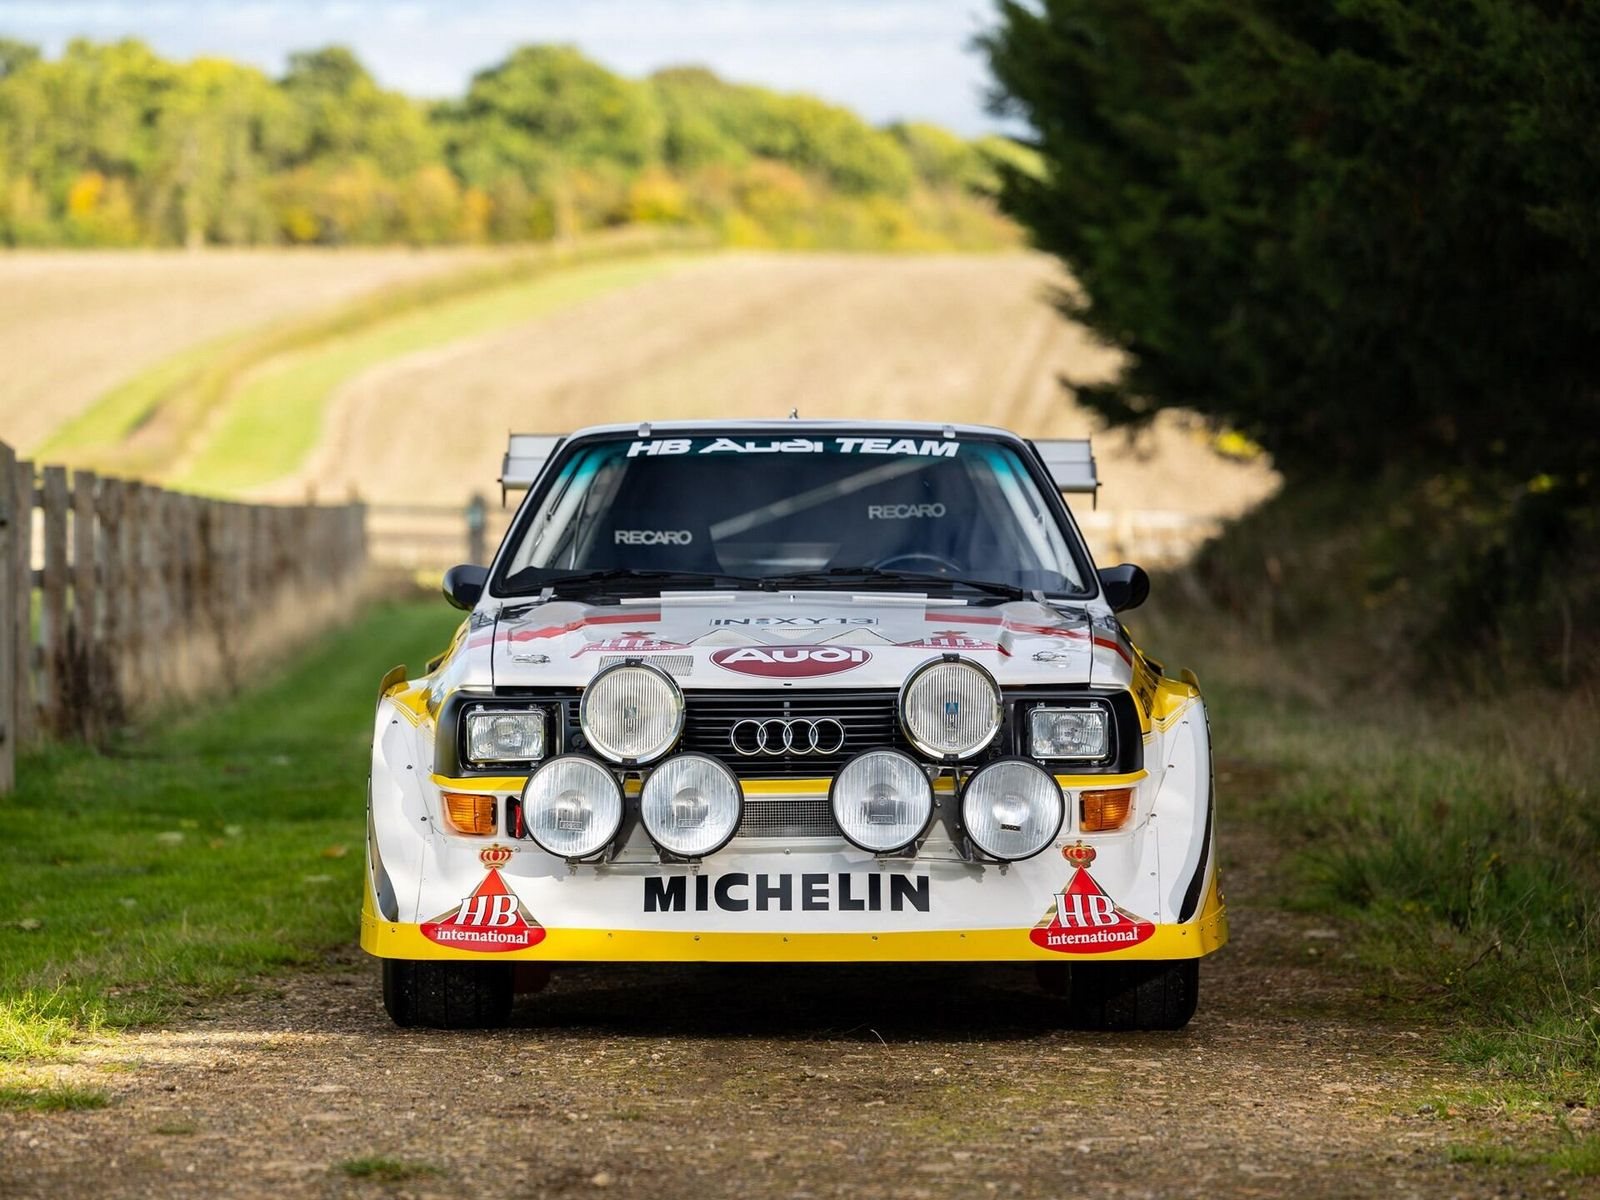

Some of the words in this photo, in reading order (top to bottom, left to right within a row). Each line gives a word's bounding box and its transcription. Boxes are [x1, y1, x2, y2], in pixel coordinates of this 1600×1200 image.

[626, 439, 692, 457] HB
[836, 437, 960, 457] TEAM
[867, 503, 946, 519] RECARO
[614, 530, 692, 545] RECARO
[643, 872, 931, 912] MICHELIN
[454, 894, 519, 927] HB
[1054, 893, 1120, 928] HB
[436, 928, 529, 944] international
[1047, 927, 1139, 946] international
